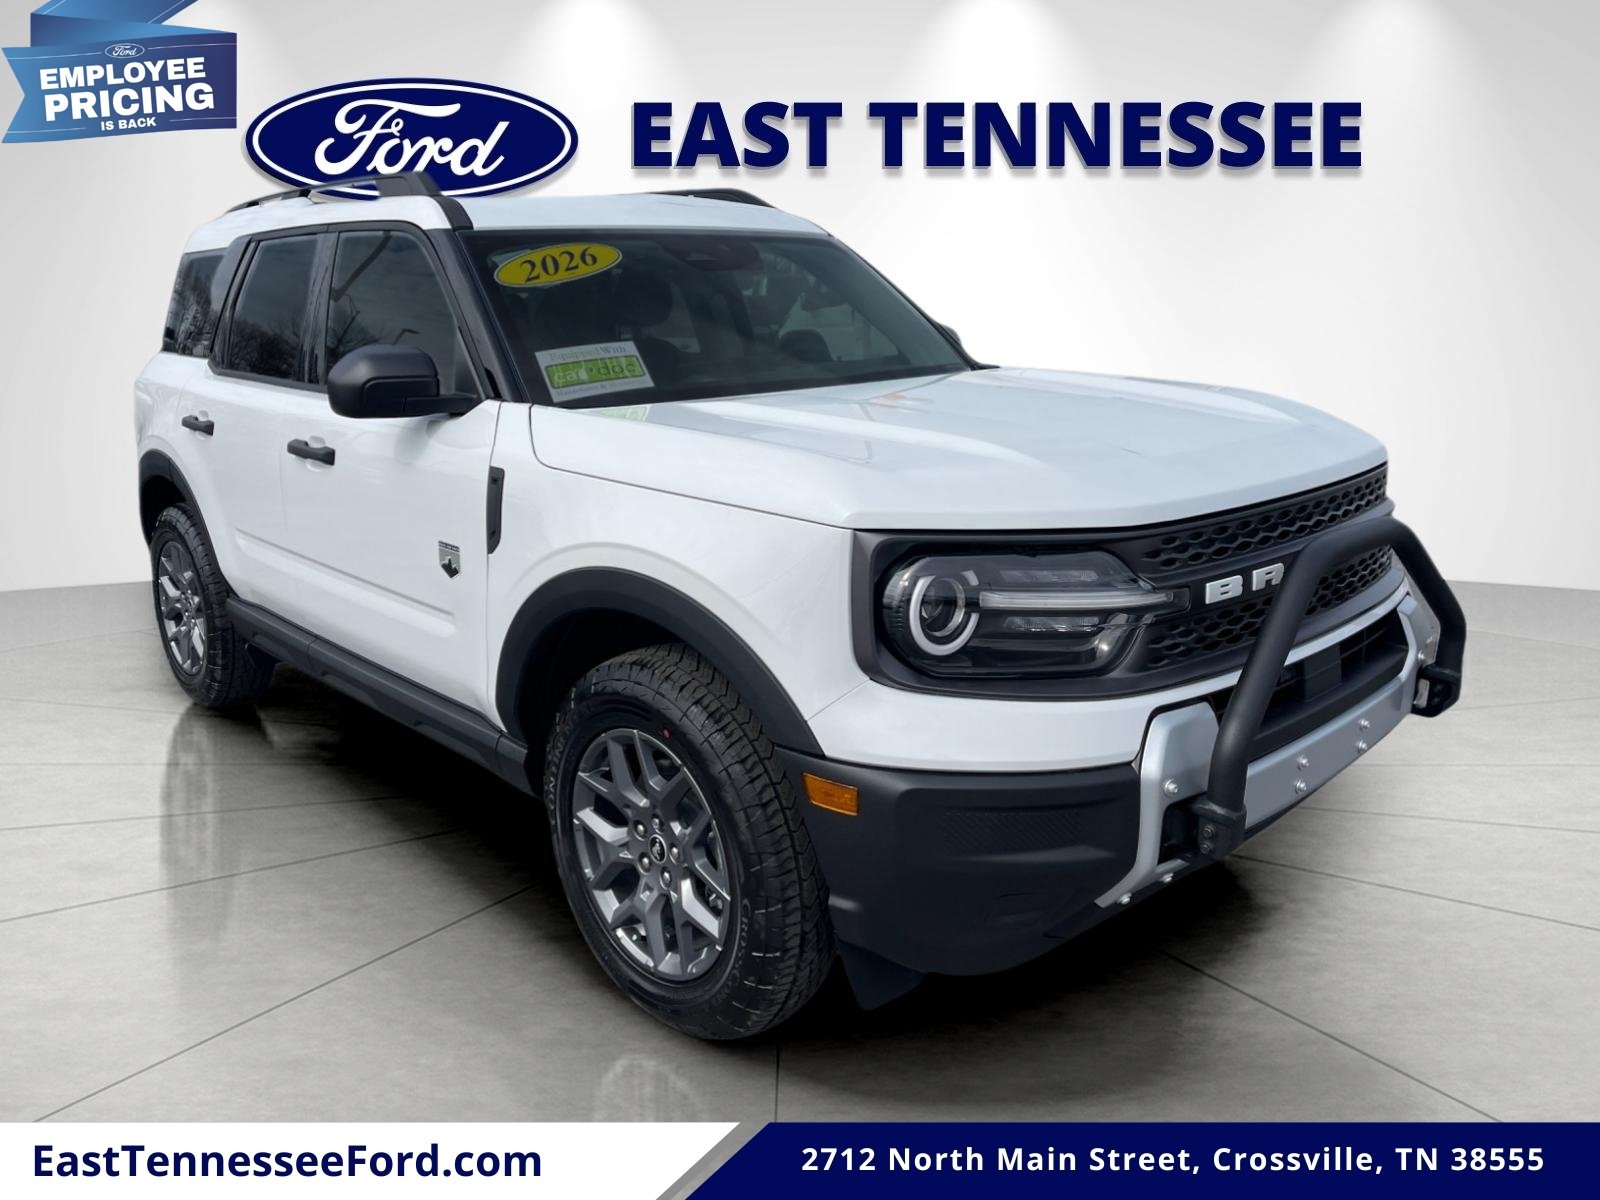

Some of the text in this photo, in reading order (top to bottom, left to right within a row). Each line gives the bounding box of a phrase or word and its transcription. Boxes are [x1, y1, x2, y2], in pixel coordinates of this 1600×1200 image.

[314, 99, 510, 176] Ford
[633, 101, 1362, 168] EAST TENNESSEE
[520, 246, 598, 283] 2026
[1205, 562, 1284, 604] BR
